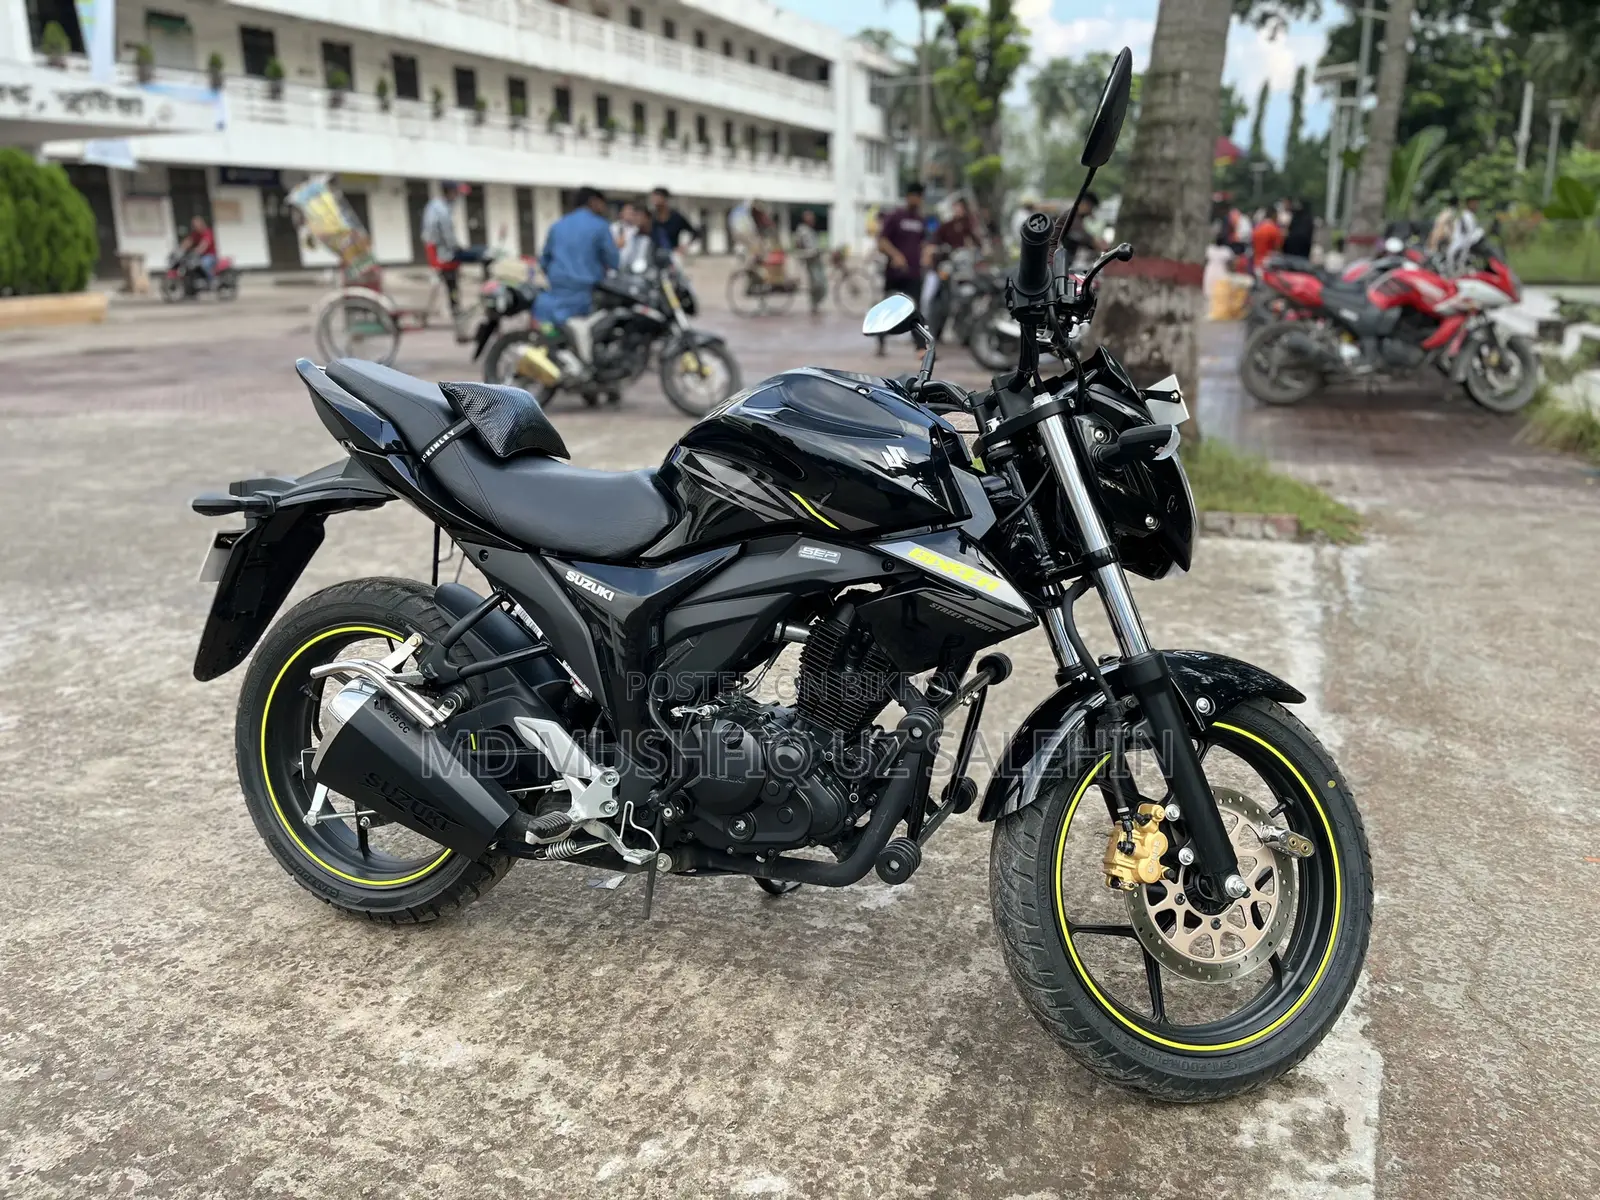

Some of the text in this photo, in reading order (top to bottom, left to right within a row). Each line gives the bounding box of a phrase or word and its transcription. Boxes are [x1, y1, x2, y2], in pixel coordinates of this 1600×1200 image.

[801, 546, 838, 558] SEP
[565, 570, 615, 602] SUZUKI
[929, 602, 997, 633] STREET SPORT
[387, 709, 411, 734] 155 CC
[364, 771, 449, 831] SUZUKI
